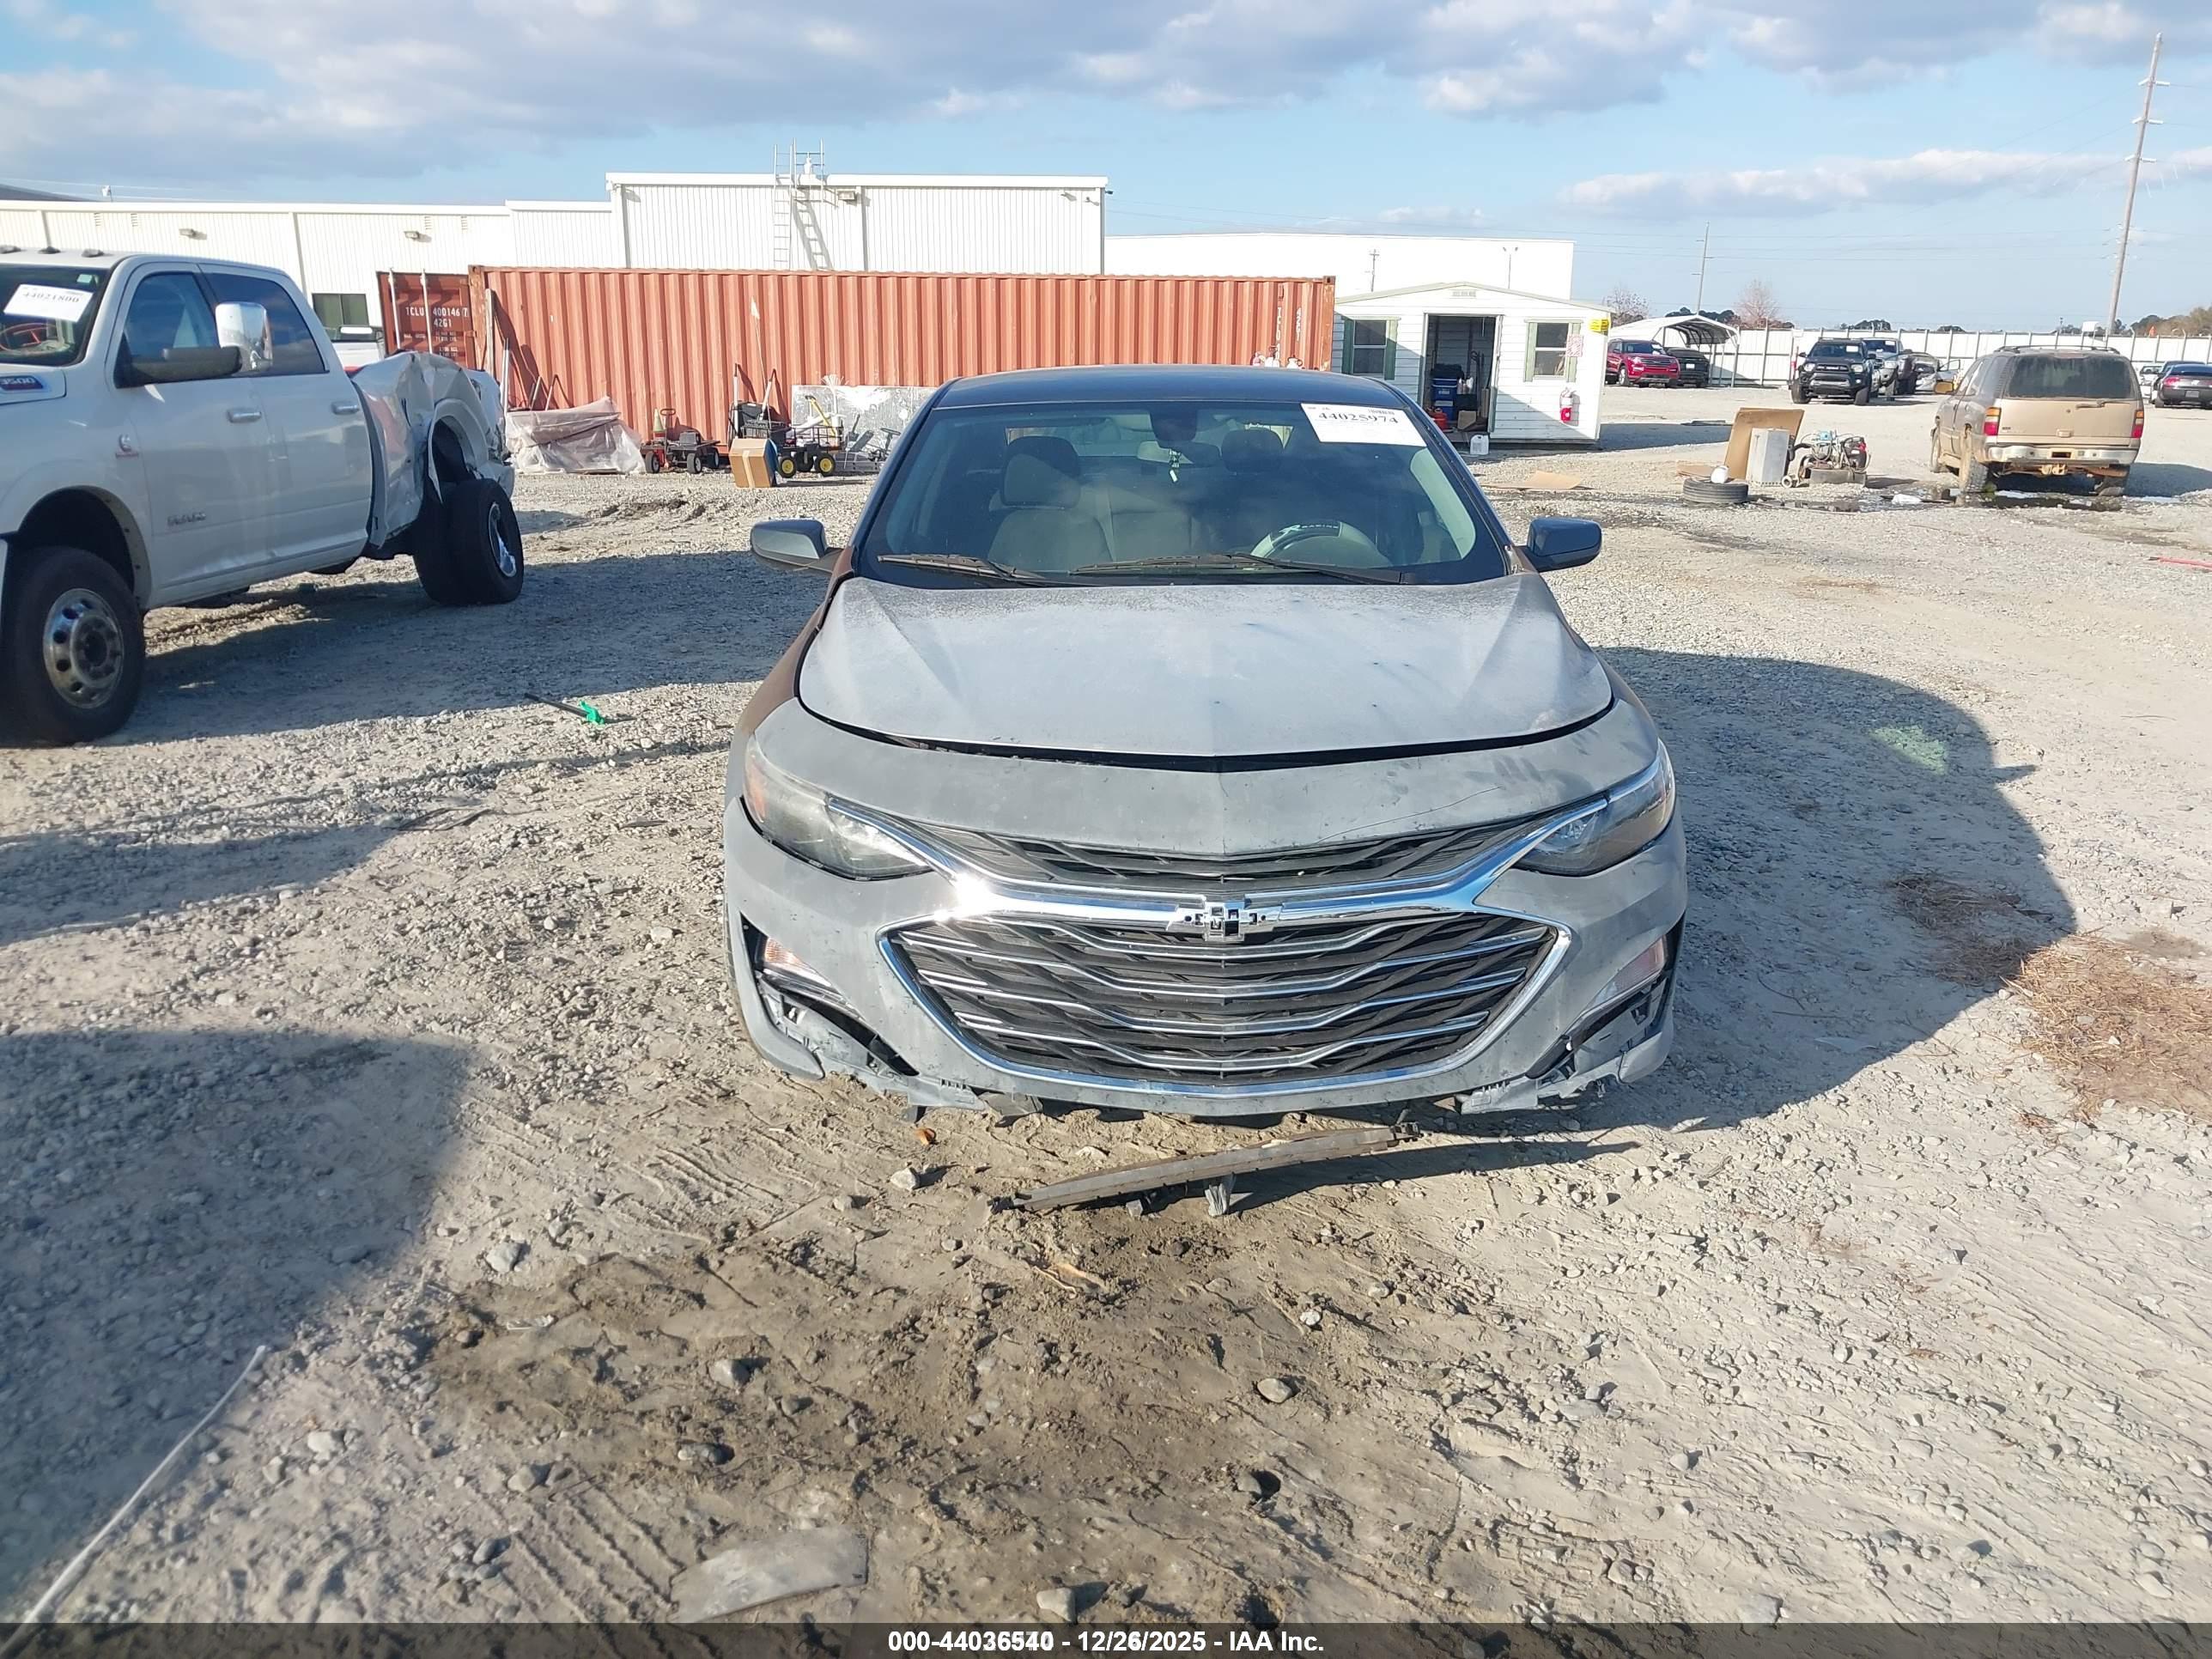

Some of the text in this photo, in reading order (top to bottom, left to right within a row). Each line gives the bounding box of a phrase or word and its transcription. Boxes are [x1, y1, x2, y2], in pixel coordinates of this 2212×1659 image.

[405, 307, 424, 316] TCLU
[433, 307, 461, 317] 400146
[1318, 412, 1399, 423] 44025974
